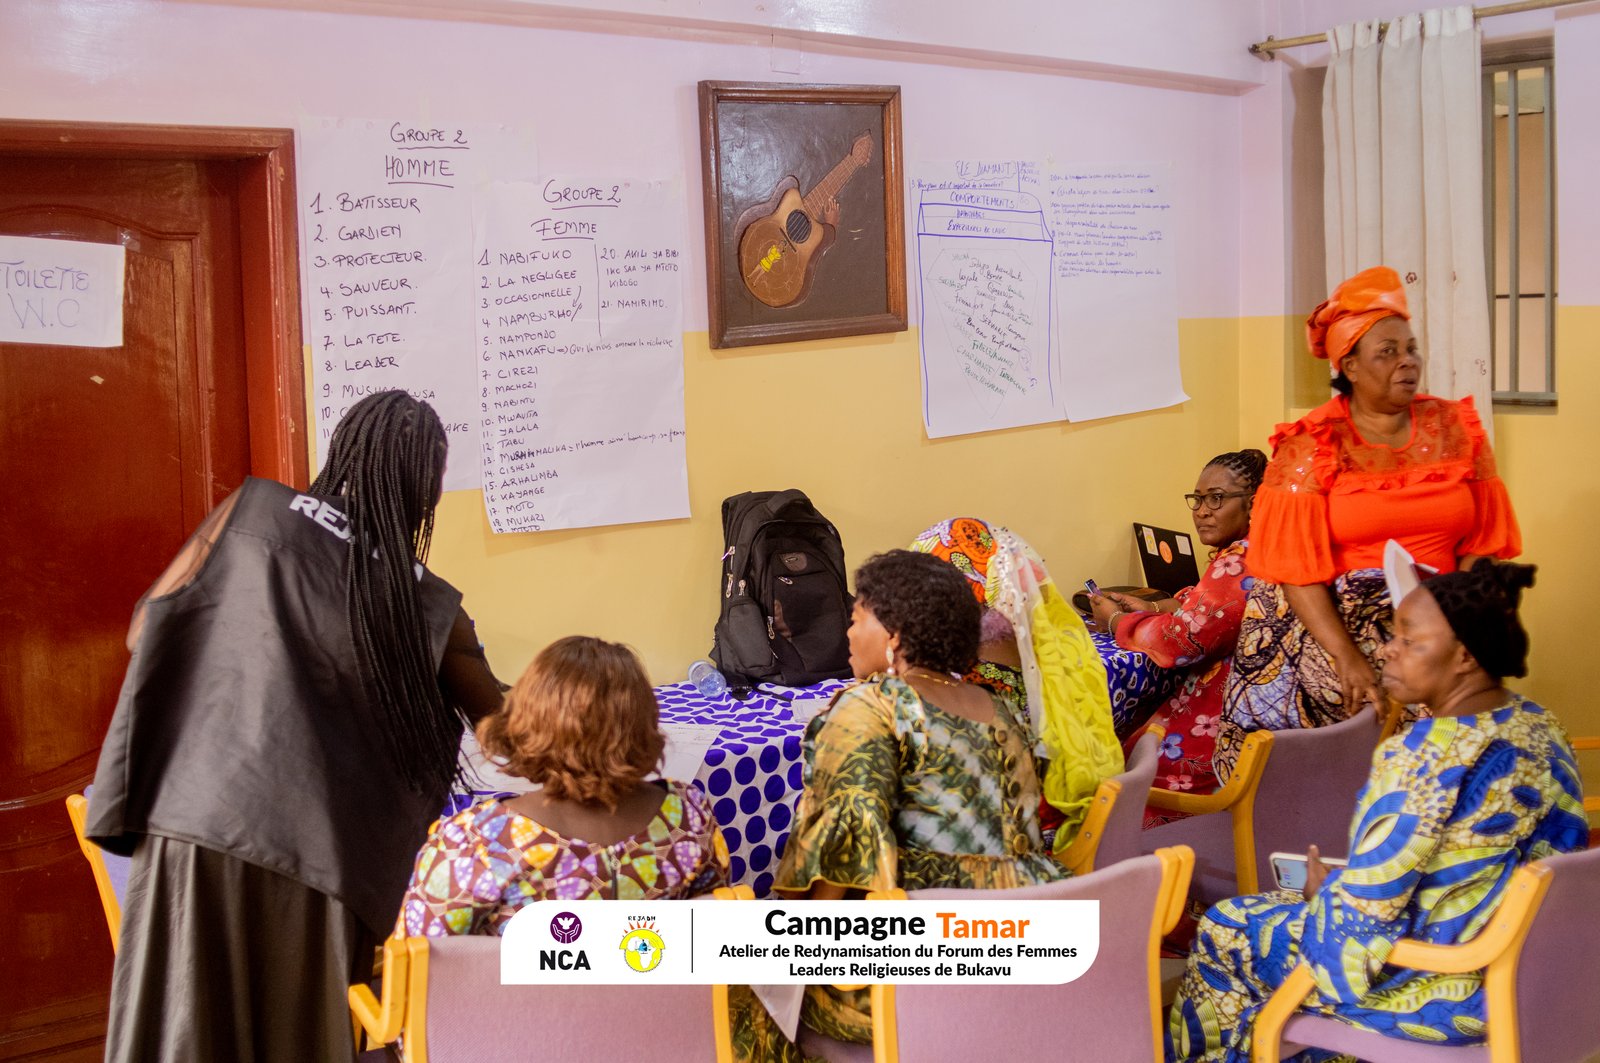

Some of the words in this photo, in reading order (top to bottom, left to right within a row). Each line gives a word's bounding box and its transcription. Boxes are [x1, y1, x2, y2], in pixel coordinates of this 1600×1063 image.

[453, 130, 468, 144] 2
[385, 155, 454, 179] HOMME
[607, 185, 621, 203] 2
[336, 193, 421, 213] BATISSEUR
[314, 224, 328, 243] 2.
[338, 224, 402, 241] GARDIEN
[531, 218, 597, 236] FEMME
[500, 250, 572, 264] NABIFUKO
[655, 263, 679, 272] MTOTO
[498, 277, 516, 288] LA
[521, 269, 577, 284] NEGLIGEE
[320, 286, 333, 299] 4.
[495, 287, 572, 305] OCCASIONNELLE
[324, 309, 336, 321] 5.
[344, 335, 363, 347] LA
[499, 329, 557, 344] NAMPONDO
[499, 344, 556, 360] NANKAFU
[325, 361, 337, 371] 8.
[344, 356, 399, 371] LEADER
[498, 366, 538, 379] CIREZI
[495, 381, 537, 395] MACHOZI
[494, 397, 535, 409] NABINTU
[482, 418, 494, 427] 10.
[497, 438, 525, 448] TABU
[499, 462, 535, 475] CISHESA
[485, 481, 497, 492] 15.
[501, 486, 545, 501] KAYANGE
[506, 500, 535, 514] MOTO
[506, 513, 546, 526] MUKAZI
